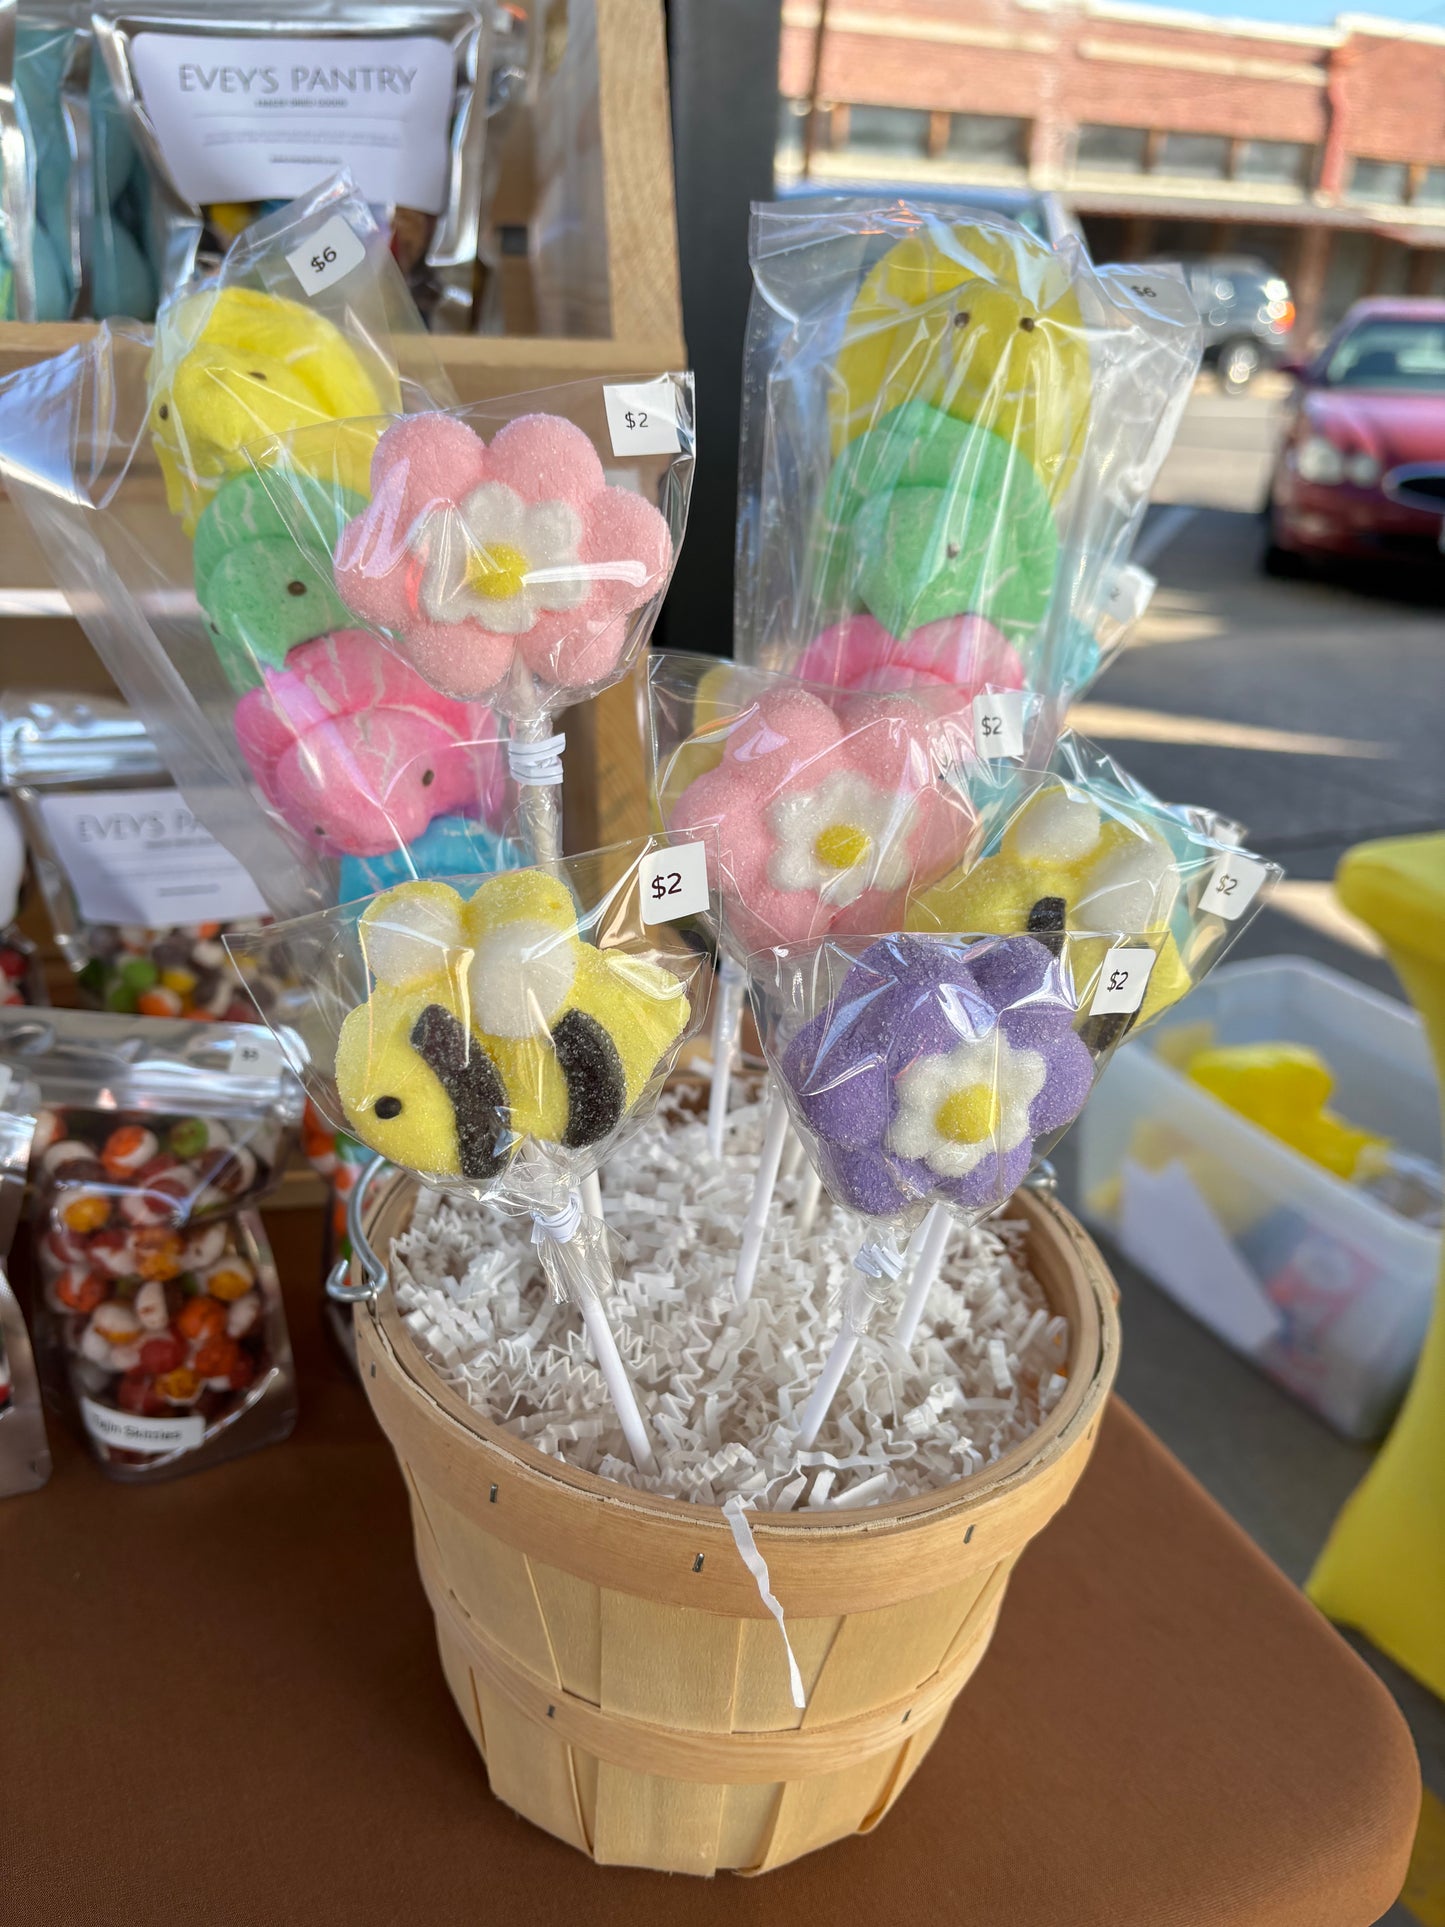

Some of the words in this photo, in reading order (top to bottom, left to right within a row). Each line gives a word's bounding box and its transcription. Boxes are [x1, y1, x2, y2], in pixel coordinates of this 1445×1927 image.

[179, 64, 279, 94] EVEY'S
[291, 65, 417, 95] PANTRY
[311, 246, 337, 273] $6
[625, 411, 649, 430] $2
[981, 715, 1003, 737] $2
[651, 872, 682, 900] $2
[1215, 874, 1238, 896] $2
[1106, 969, 1129, 992] $2
